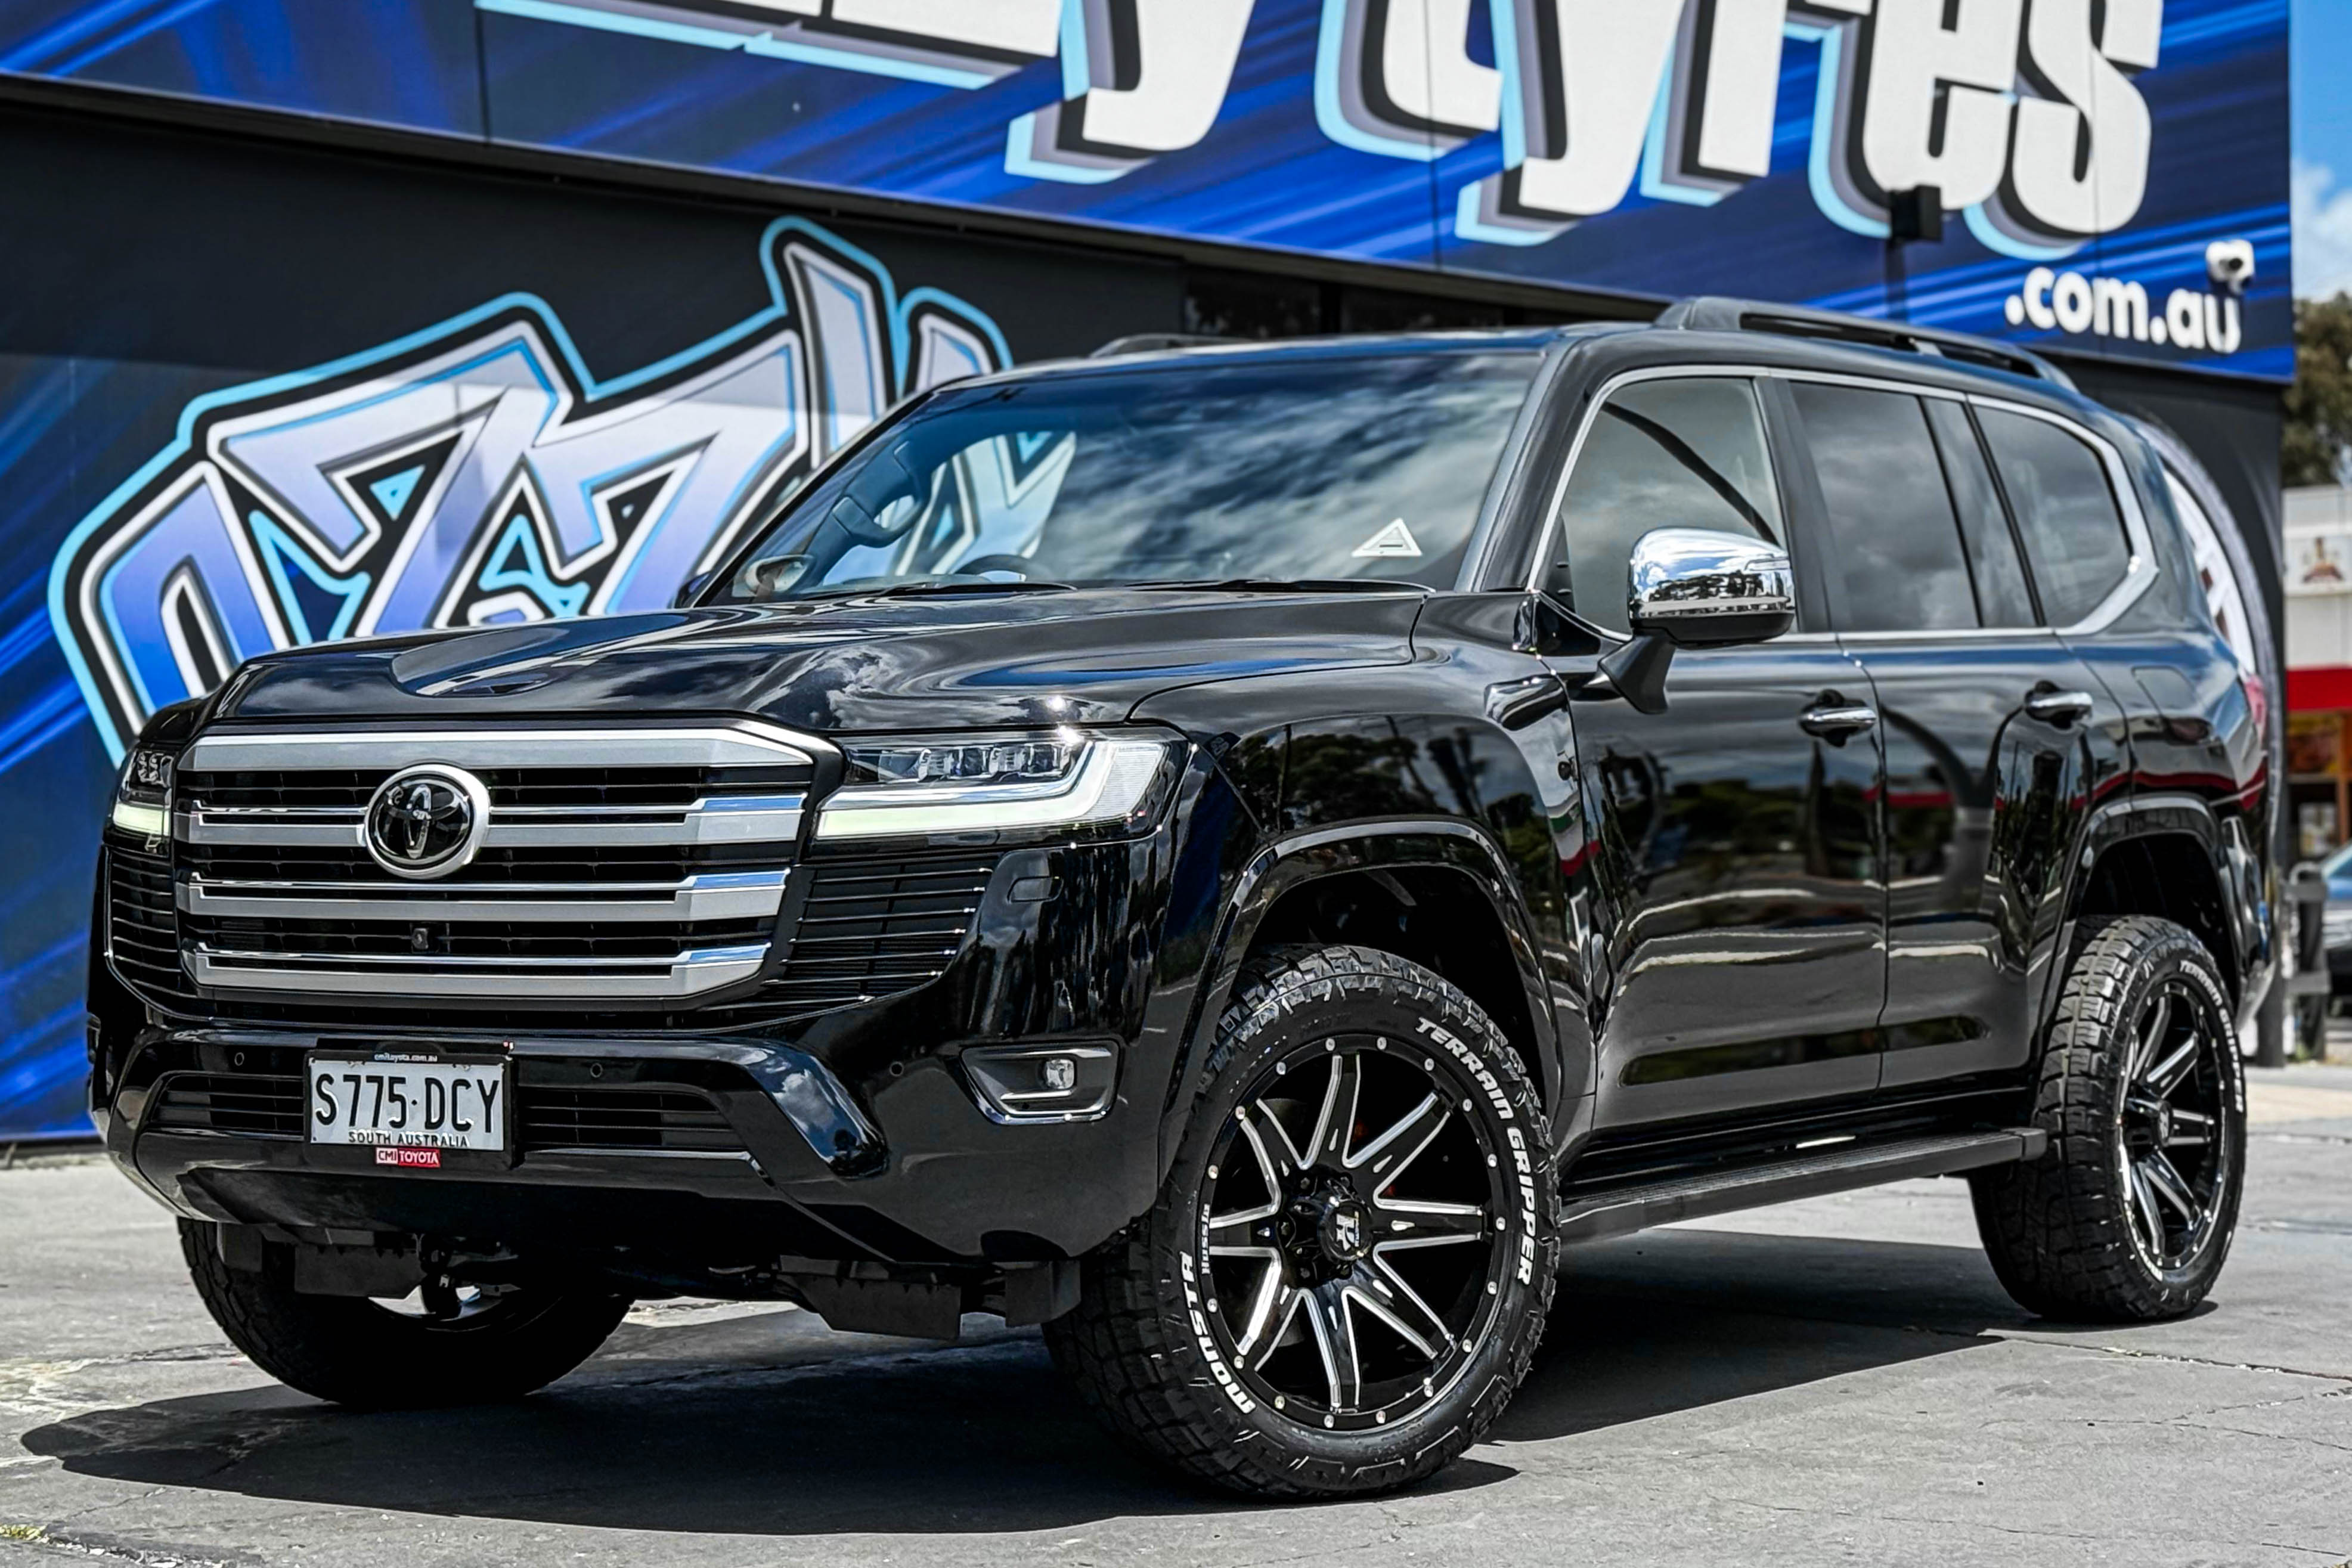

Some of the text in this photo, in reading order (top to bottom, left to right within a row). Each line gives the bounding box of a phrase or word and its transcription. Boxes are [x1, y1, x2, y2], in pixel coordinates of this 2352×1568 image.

[2004, 267, 2242, 354] .com.au
[348, 1130, 469, 1147] SOUTH AUSTRALIA
[399, 1149, 439, 1164] TOYOTA
[1415, 1017, 1536, 1285] TERRAIN GRIPPER
[1179, 1251, 1256, 1414] MONSTA
